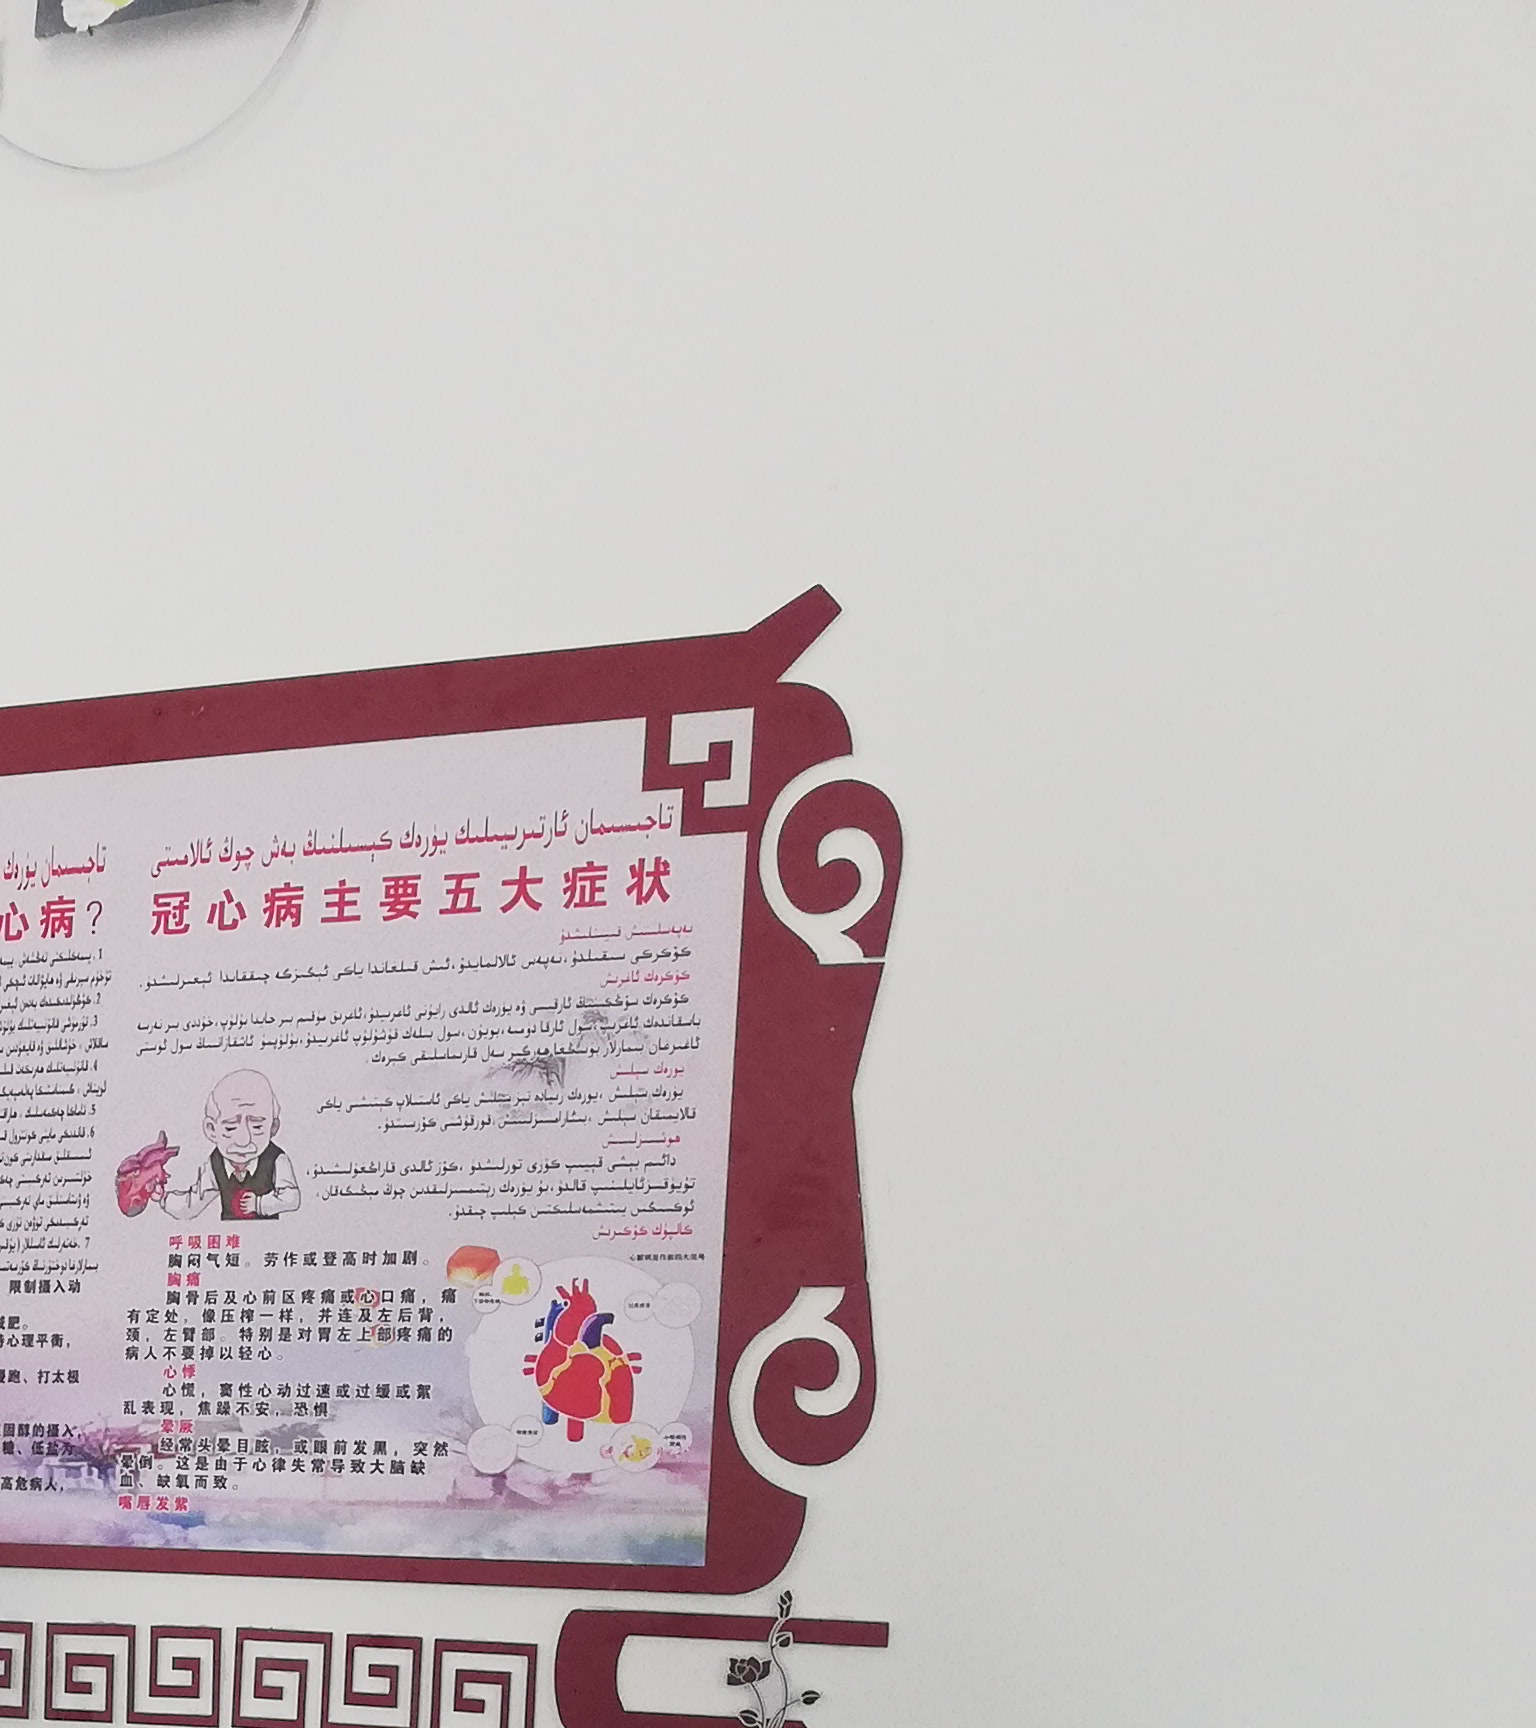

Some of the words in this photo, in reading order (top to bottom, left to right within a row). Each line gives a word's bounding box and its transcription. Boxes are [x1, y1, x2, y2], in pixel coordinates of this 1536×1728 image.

[149, 852, 673, 940] 冠心病主要五大症状
[167, 1232, 241, 1251] 呼吸困难
[166, 1248, 430, 1269] 胸闷气短。劳作或登高时加剧。
[165, 1270, 201, 1288] 胸痛
[165, 1286, 458, 1306] 胸骨后及心前区疼痛或心口痛，痛
[124, 1344, 284, 1361] 病人不要掉以轻心。
[161, 1363, 196, 1379] 心悸
[119, 1453, 427, 1475] 晕倒。这是由于心律失常导致大脑缺
[118, 1472, 239, 1491] 血、缺氧而致。
[117, 1494, 189, 1512] 嘴唇发紫
